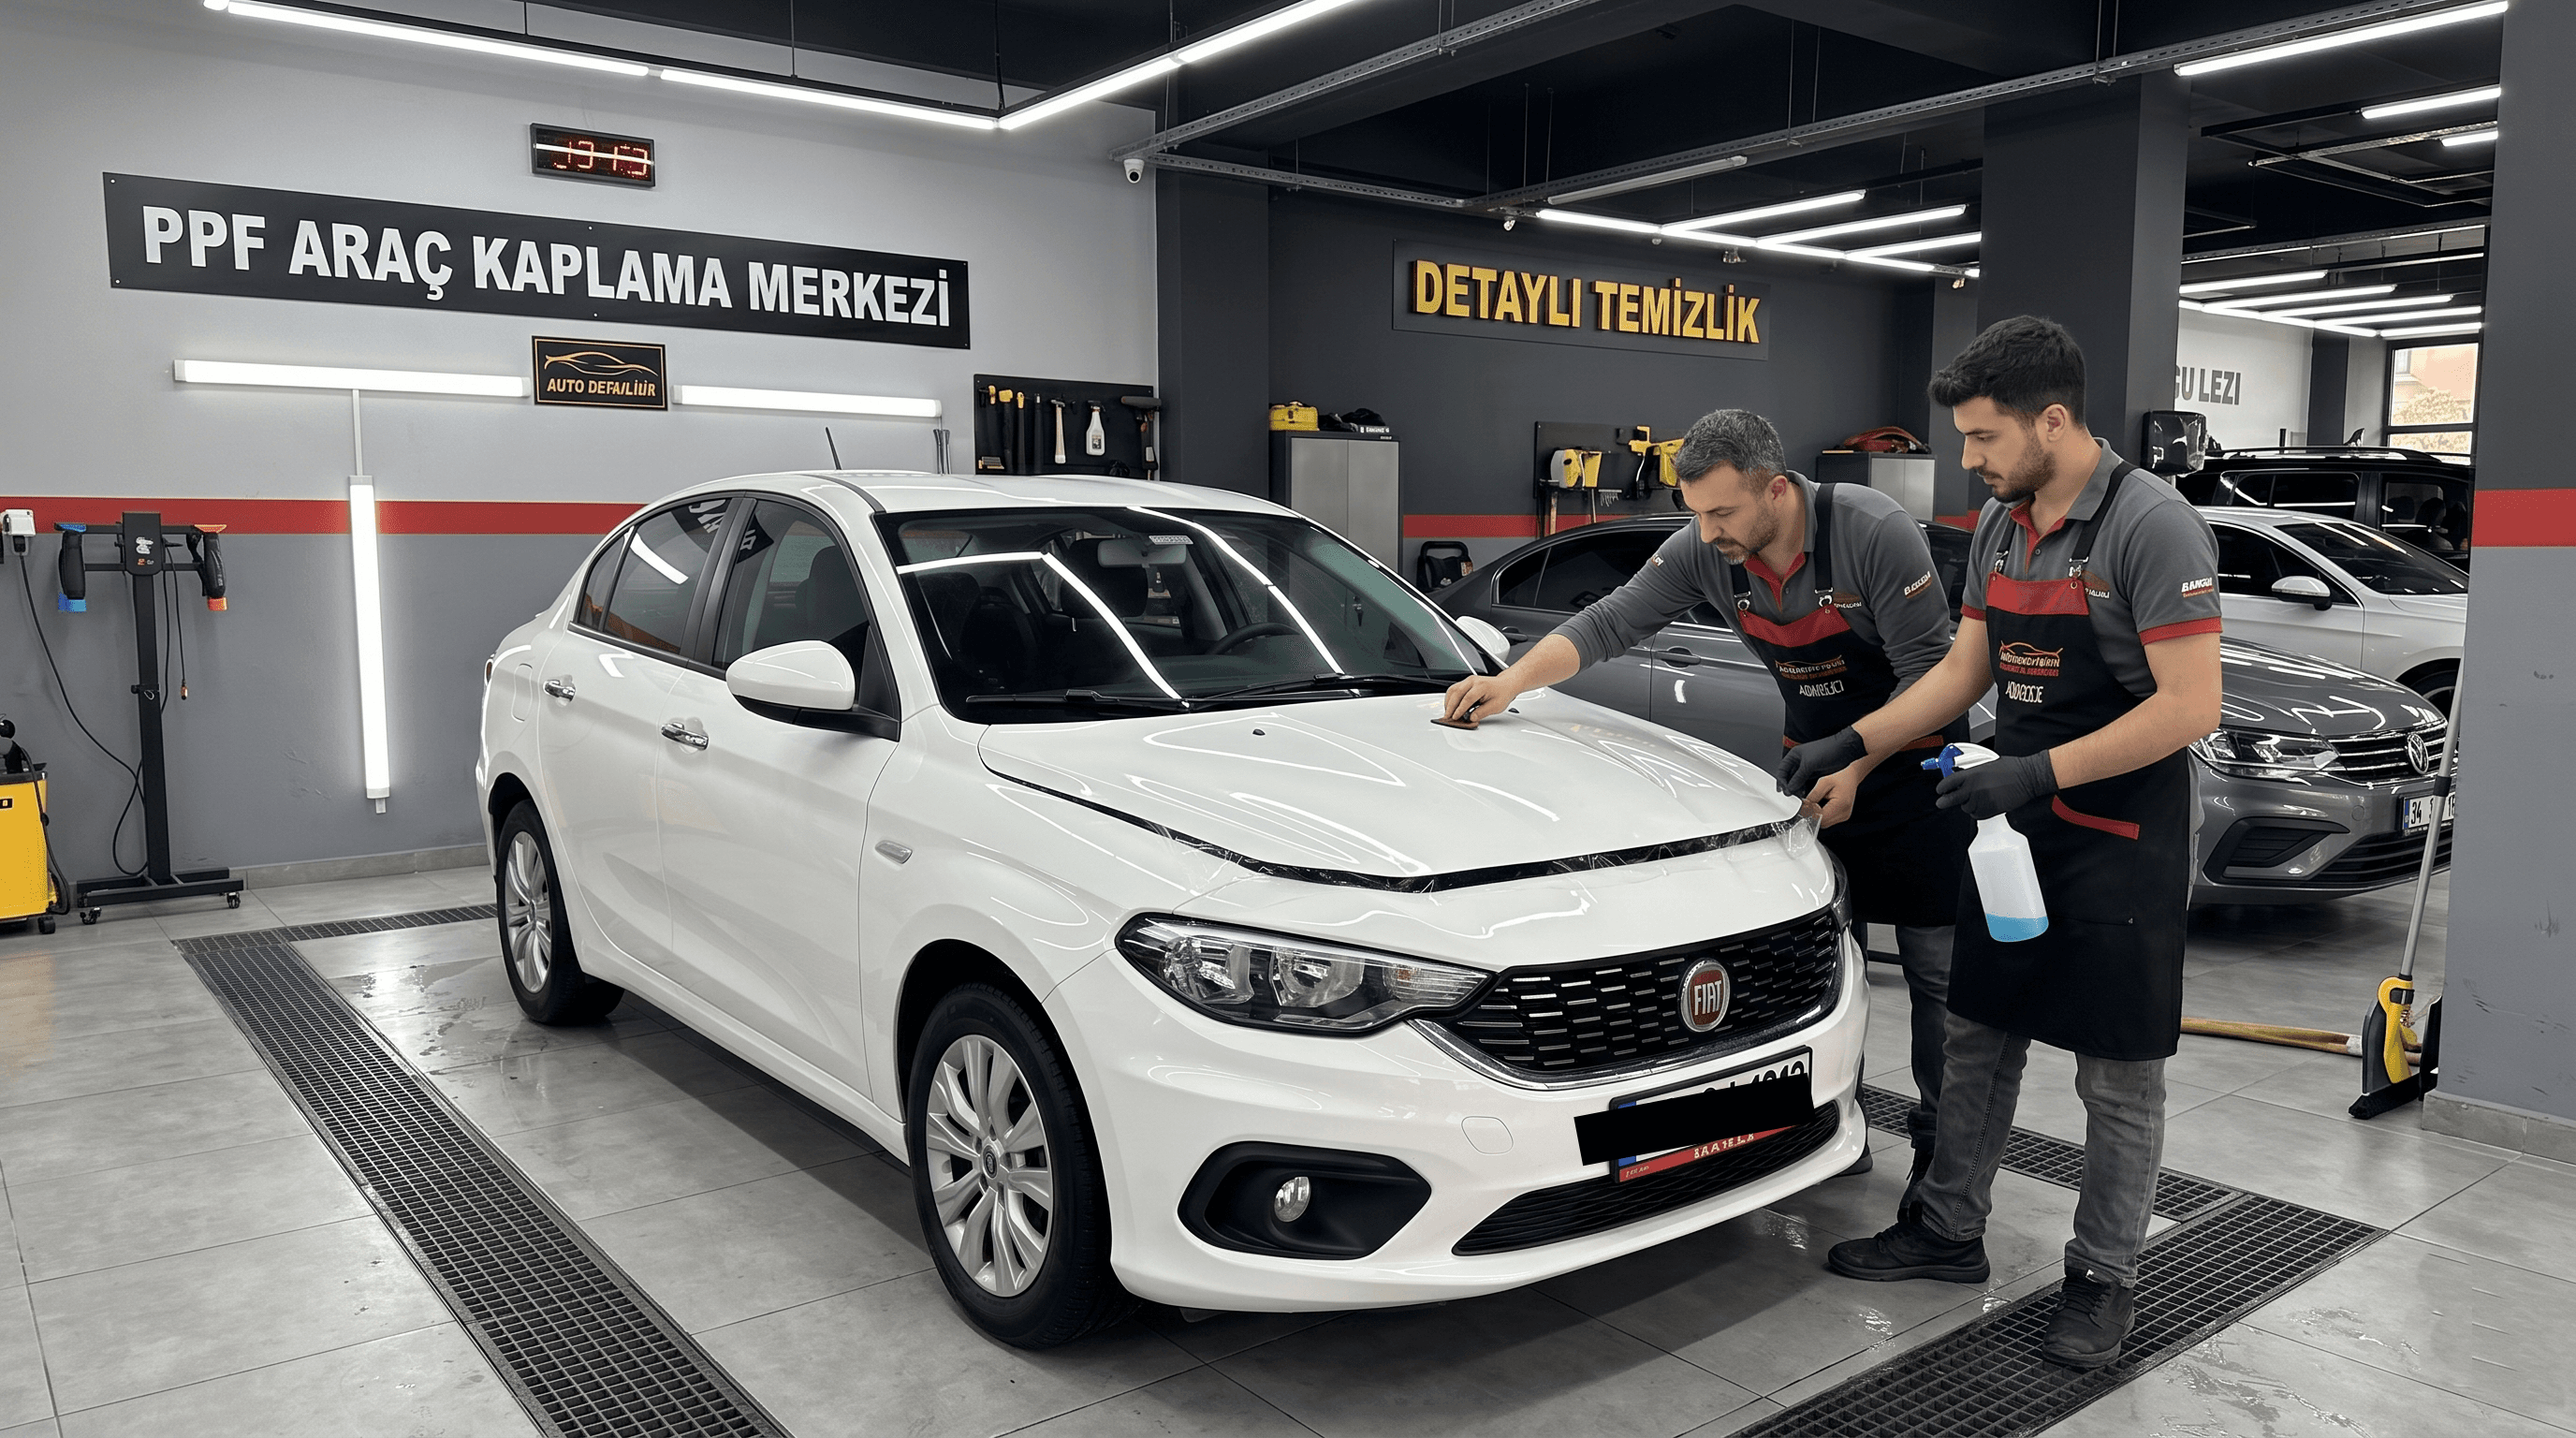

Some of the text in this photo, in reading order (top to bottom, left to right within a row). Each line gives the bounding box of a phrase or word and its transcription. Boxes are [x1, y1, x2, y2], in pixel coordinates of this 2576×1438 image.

[143, 206, 949, 327] PPF ARAÇ KAPLAMA MERKEZİ
[1414, 260, 1760, 344] DETAYLI TEMİZLİK
[547, 378, 585, 393] AUTO
[2199, 368, 2241, 405] LEZI
[2410, 800, 2422, 825] 34
[1694, 979, 1722, 1016] FIAT
